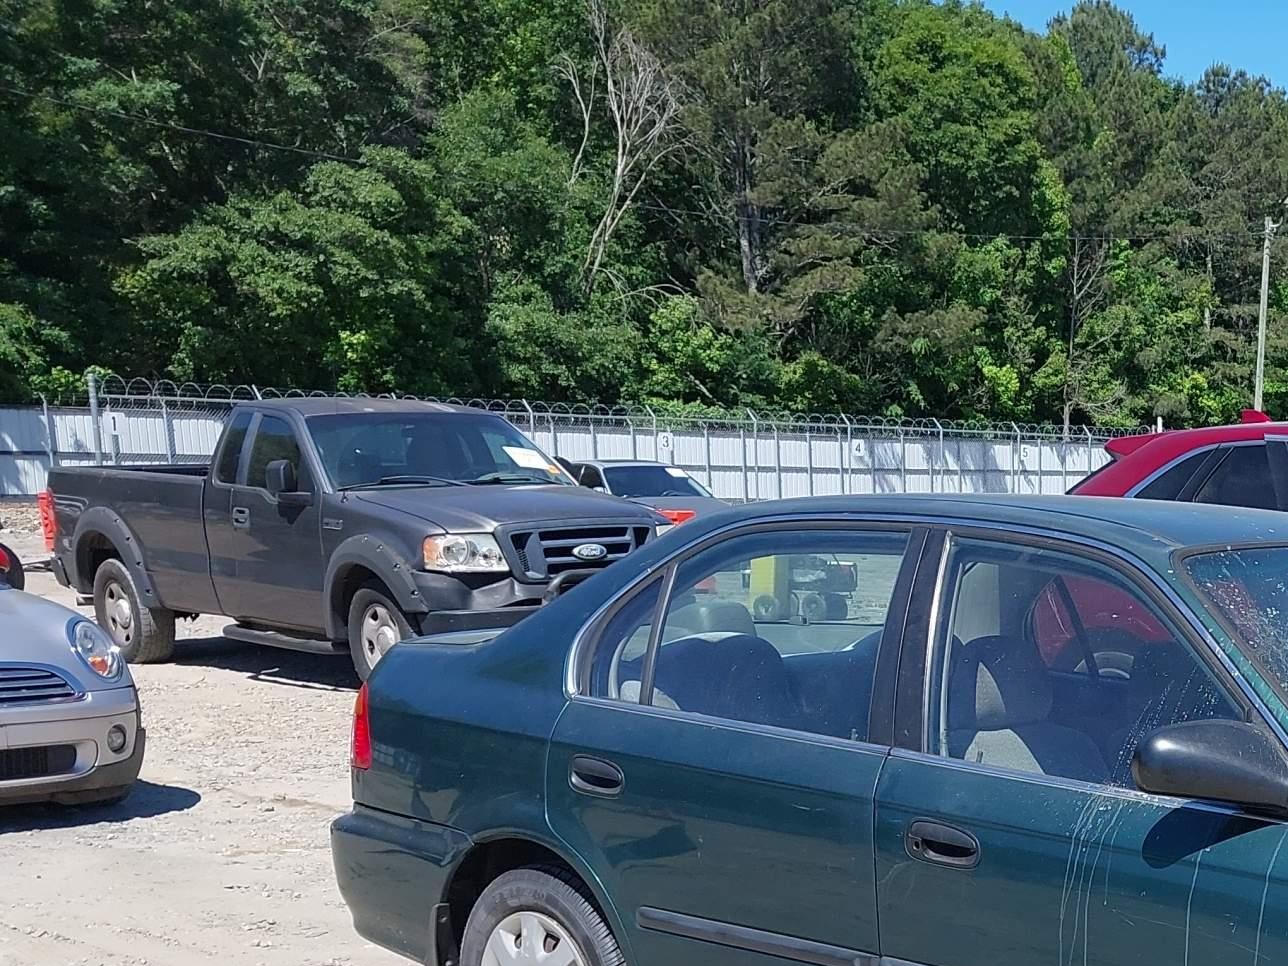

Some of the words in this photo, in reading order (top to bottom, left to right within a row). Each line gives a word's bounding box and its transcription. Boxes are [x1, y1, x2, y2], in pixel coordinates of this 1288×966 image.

[111, 416, 117, 431] 1
[662, 435, 669, 447] 3
[855, 442, 861, 453] 4
[1022, 447, 1028, 458] 5
